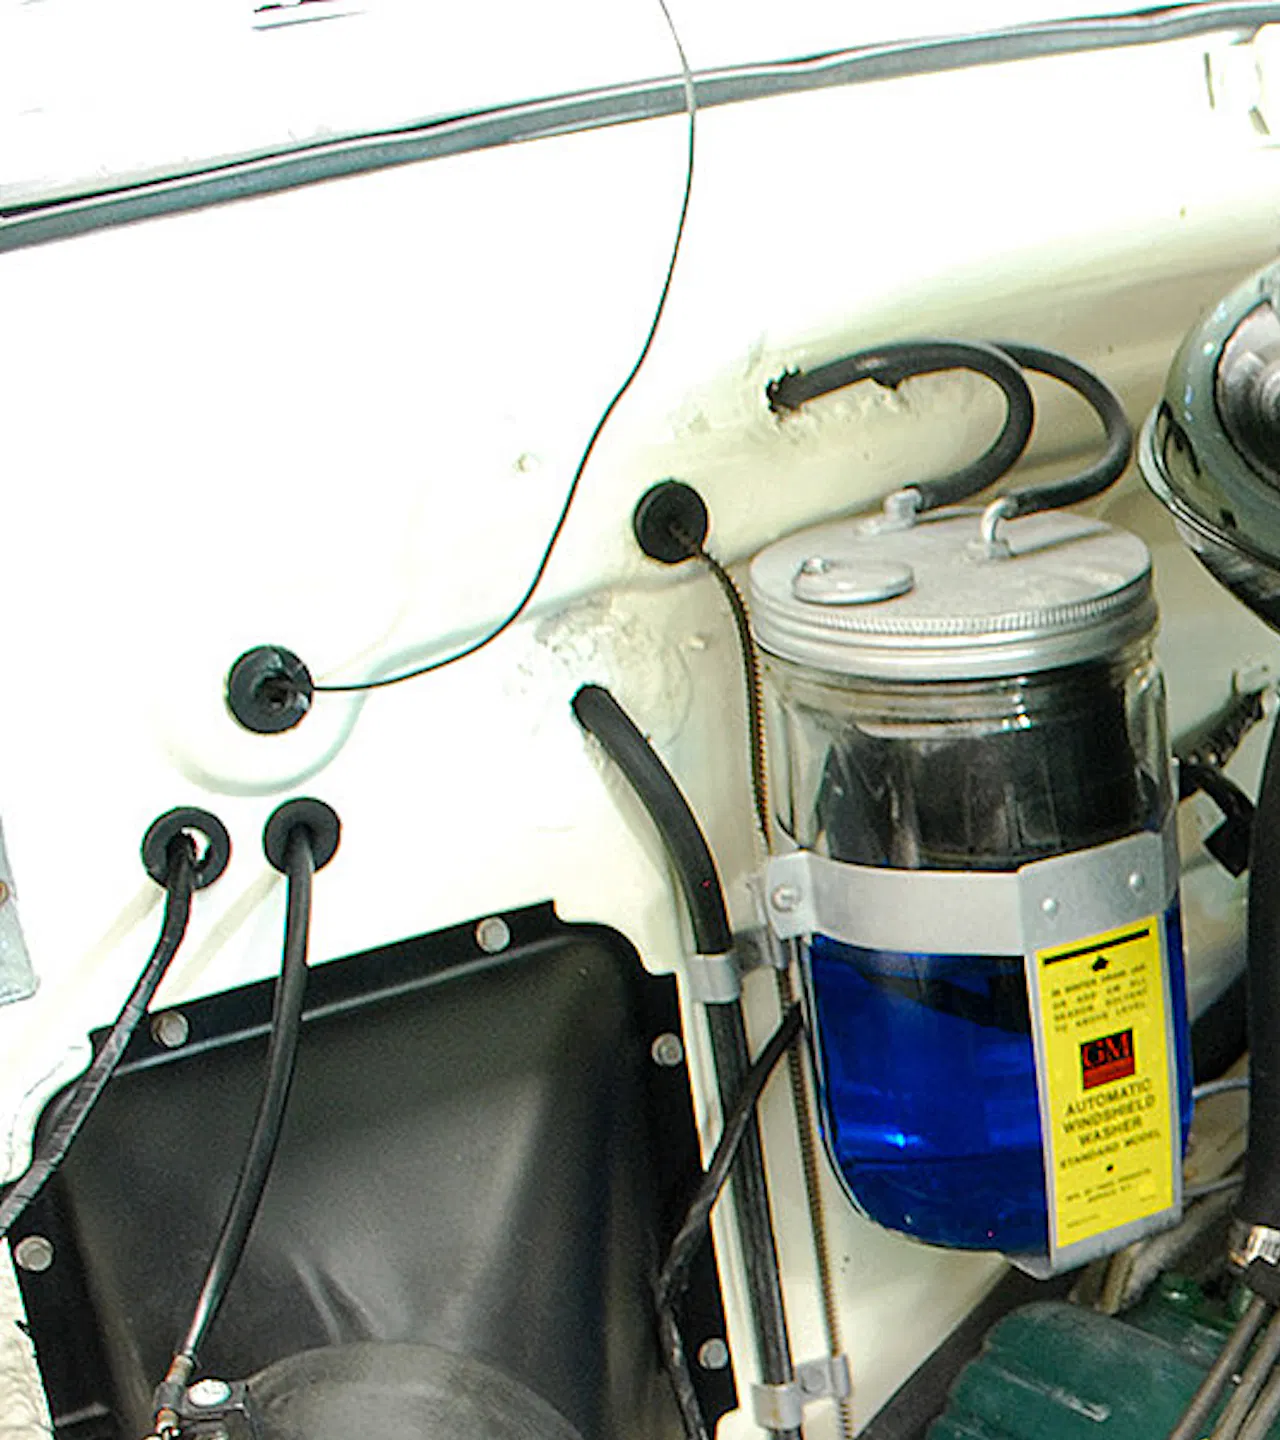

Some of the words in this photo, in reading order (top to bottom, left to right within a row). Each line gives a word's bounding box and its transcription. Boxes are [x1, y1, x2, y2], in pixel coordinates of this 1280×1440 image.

[1083, 1031, 1131, 1068] GM
[1062, 1093, 1156, 1134] WINDSHIELD
[1065, 1076, 1153, 1117] AUTOMATIC
[1060, 1140, 1120, 1169] STANDARD
[1124, 1129, 1161, 1148] MODEL
[1078, 1114, 1142, 1146] WASHER
